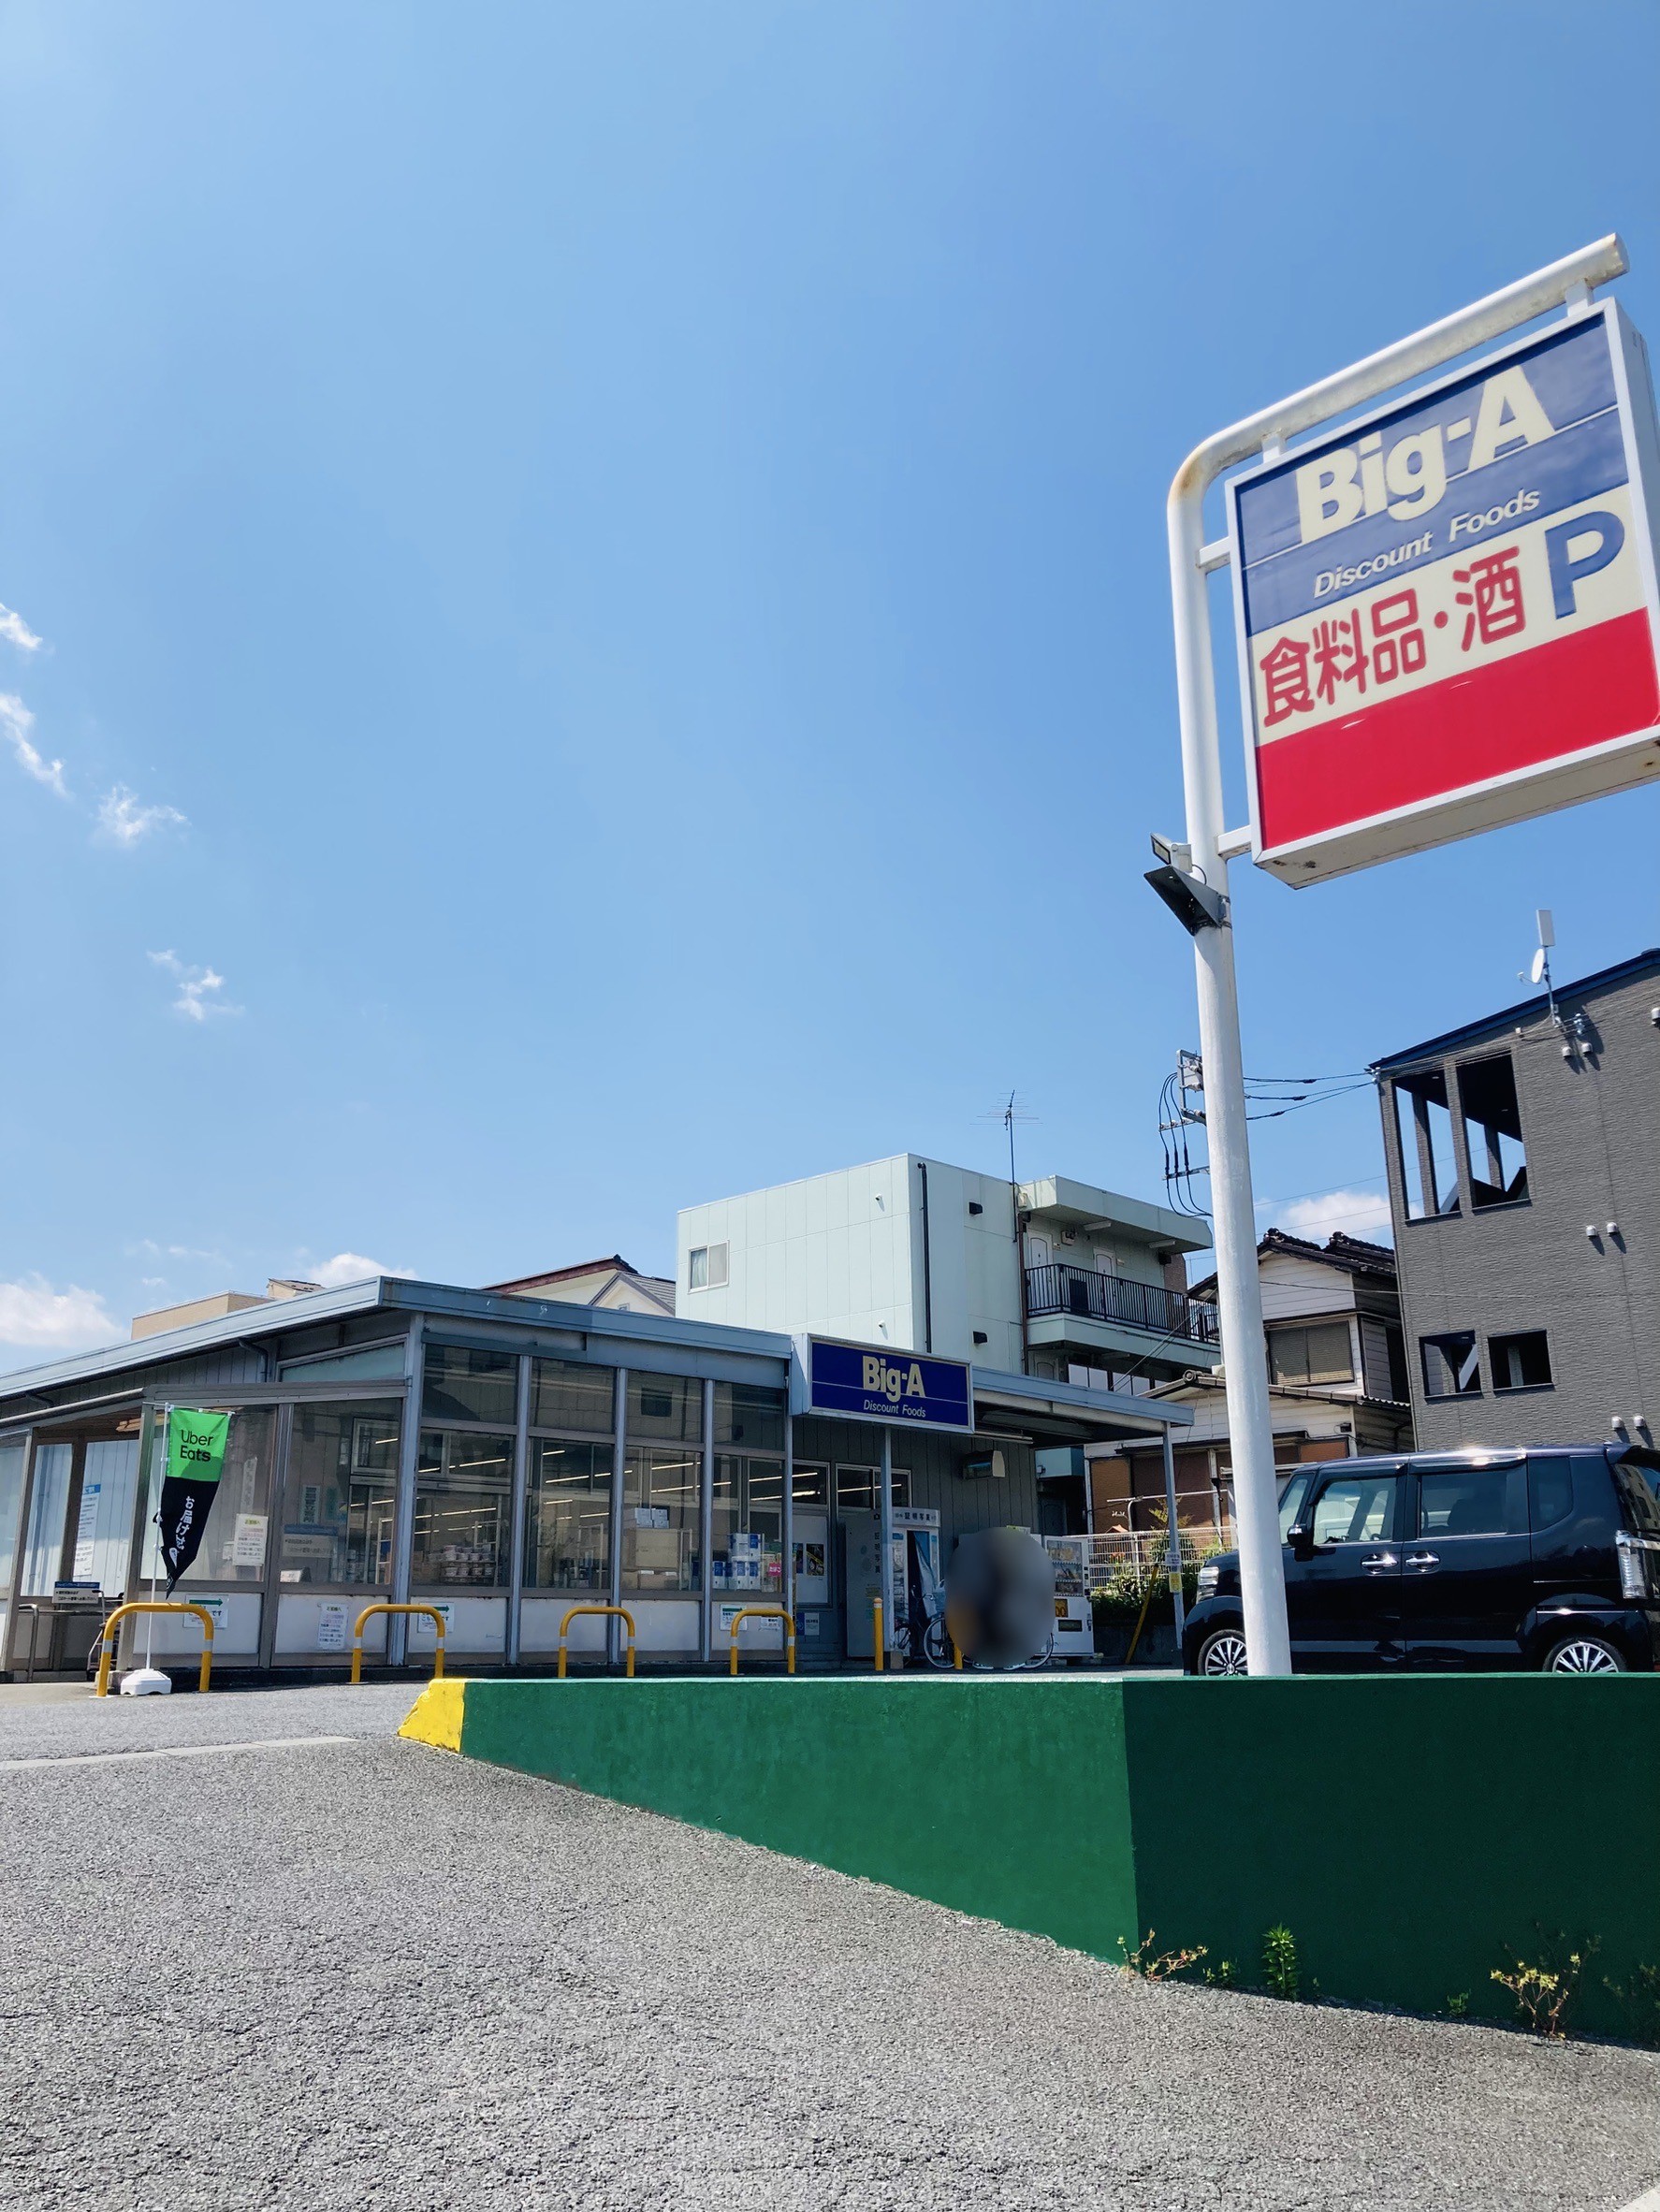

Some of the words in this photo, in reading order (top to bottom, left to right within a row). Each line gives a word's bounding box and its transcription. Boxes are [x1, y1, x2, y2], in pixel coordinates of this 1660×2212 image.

[1294, 365, 1555, 544] Big-A
[1313, 531, 1434, 599] Discount
[1449, 488, 1540, 544] Foods
[1544, 510, 1625, 619] P
[863, 1355, 926, 1403] Big-A
[864, 1399, 898, 1414] Discount
[902, 1404, 926, 1418] Foods
[180, 1445, 211, 1463] Eats
[181, 1429, 214, 1447] Uber
